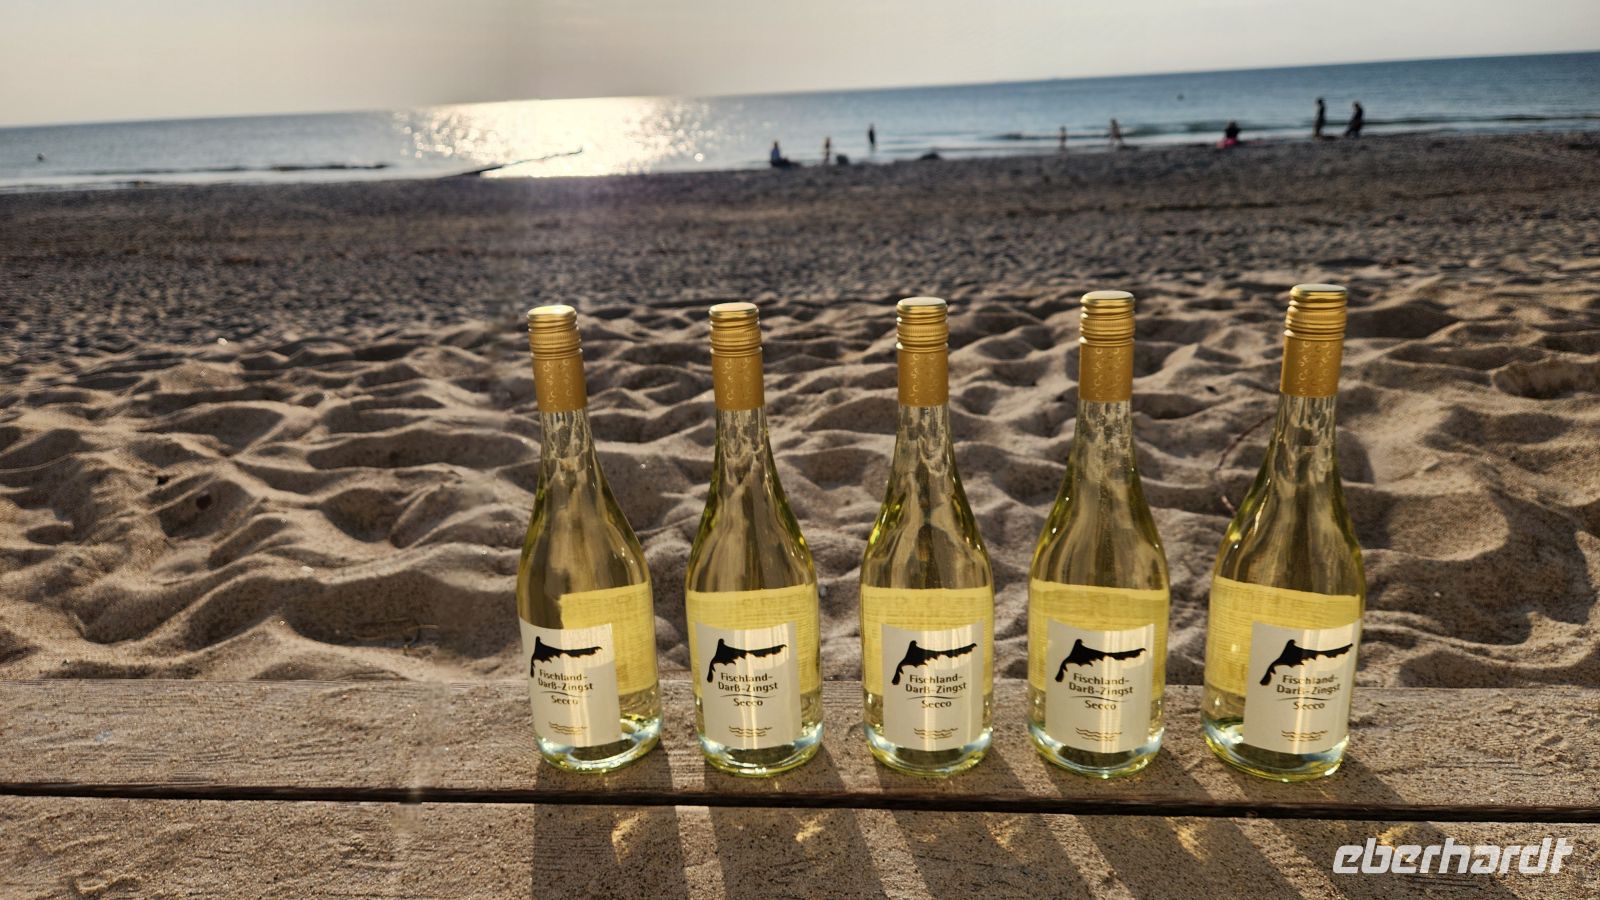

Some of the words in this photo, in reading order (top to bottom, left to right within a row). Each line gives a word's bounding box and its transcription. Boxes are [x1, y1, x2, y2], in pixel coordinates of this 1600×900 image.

[539, 668, 588, 682] Fischland-
[720, 672, 774, 682] Fischland-
[909, 673, 964, 684] Fischland-
[1073, 672, 1130, 685] Fischland-
[538, 678, 594, 693] Darß-Zingst
[718, 682, 778, 693] Darß-Zingst
[1069, 682, 1134, 697] Darß-Zingst
[550, 695, 579, 705] Secco
[733, 698, 763, 707] Secco
[921, 699, 952, 709] Secco
[1084, 700, 1117, 711] Secco
[1292, 701, 1326, 711] Secco
